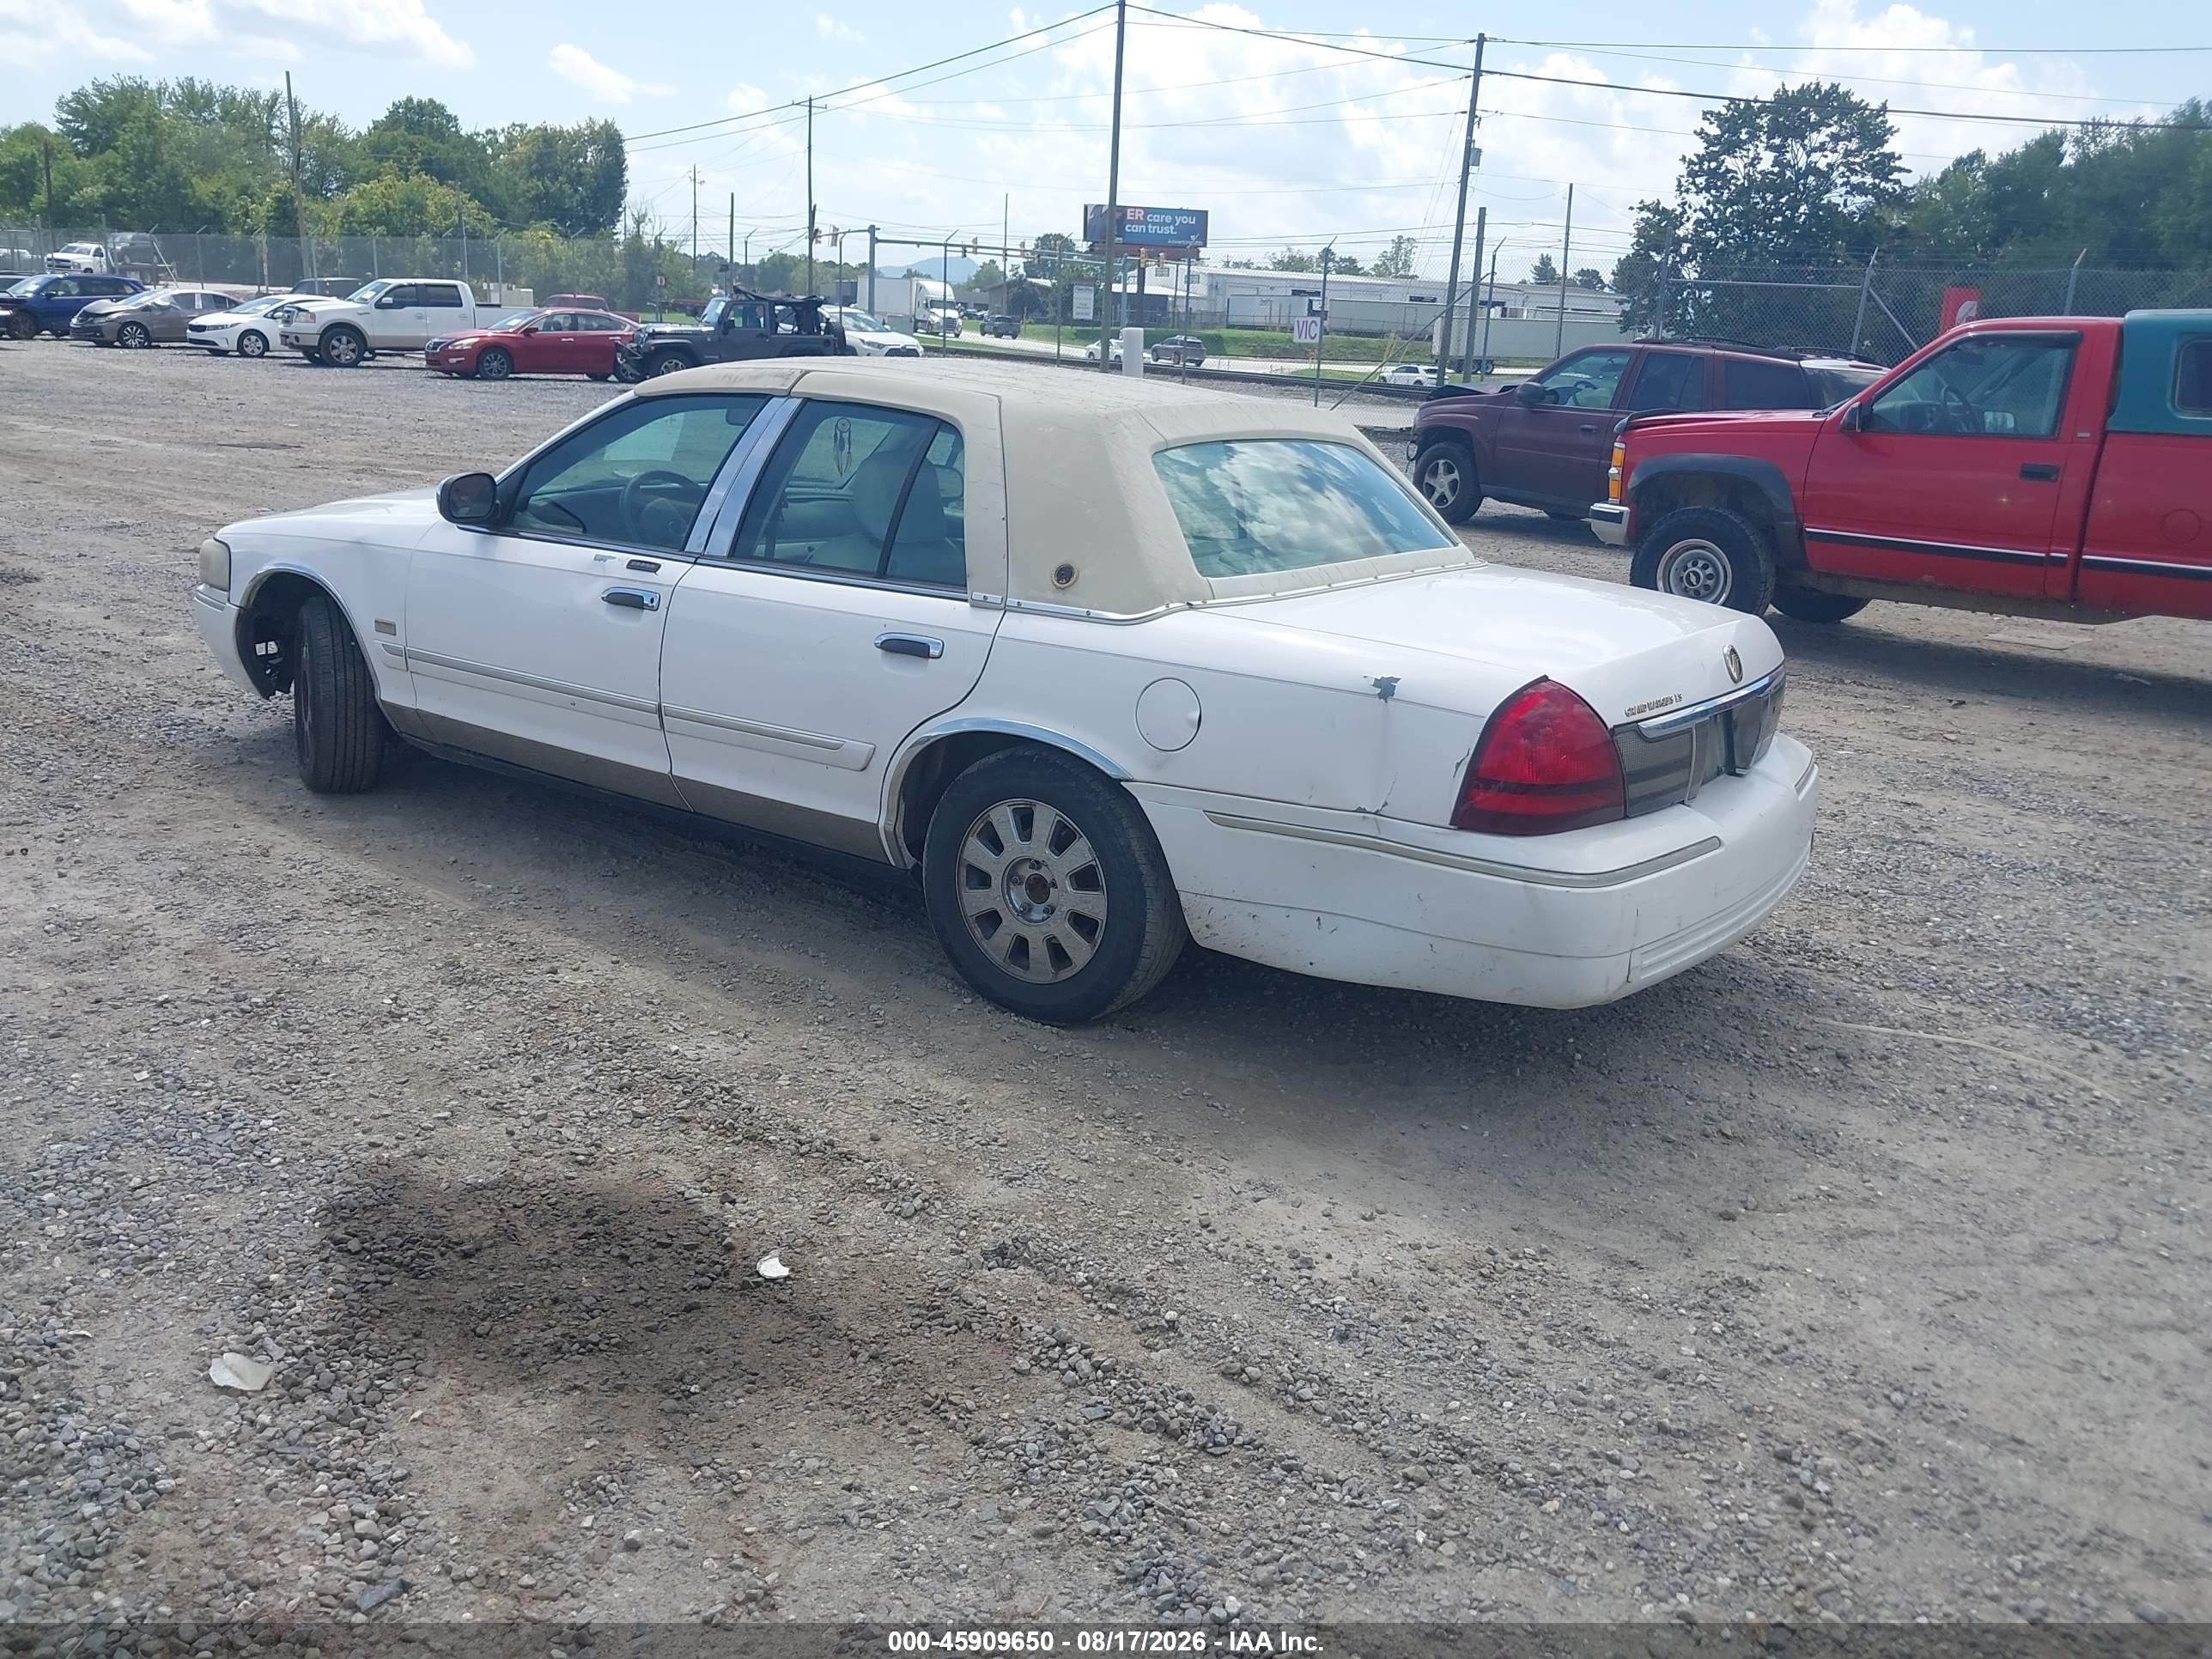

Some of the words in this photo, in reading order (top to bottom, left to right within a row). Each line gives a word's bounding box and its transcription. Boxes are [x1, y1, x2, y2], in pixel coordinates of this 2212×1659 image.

[1126, 208, 1145, 221] ER
[1146, 213, 1172, 223] care
[1175, 215, 1196, 226] you
[1125, 223, 1146, 233] can
[1147, 223, 1177, 234] trust.
[1297, 319, 1318, 340] VIC
